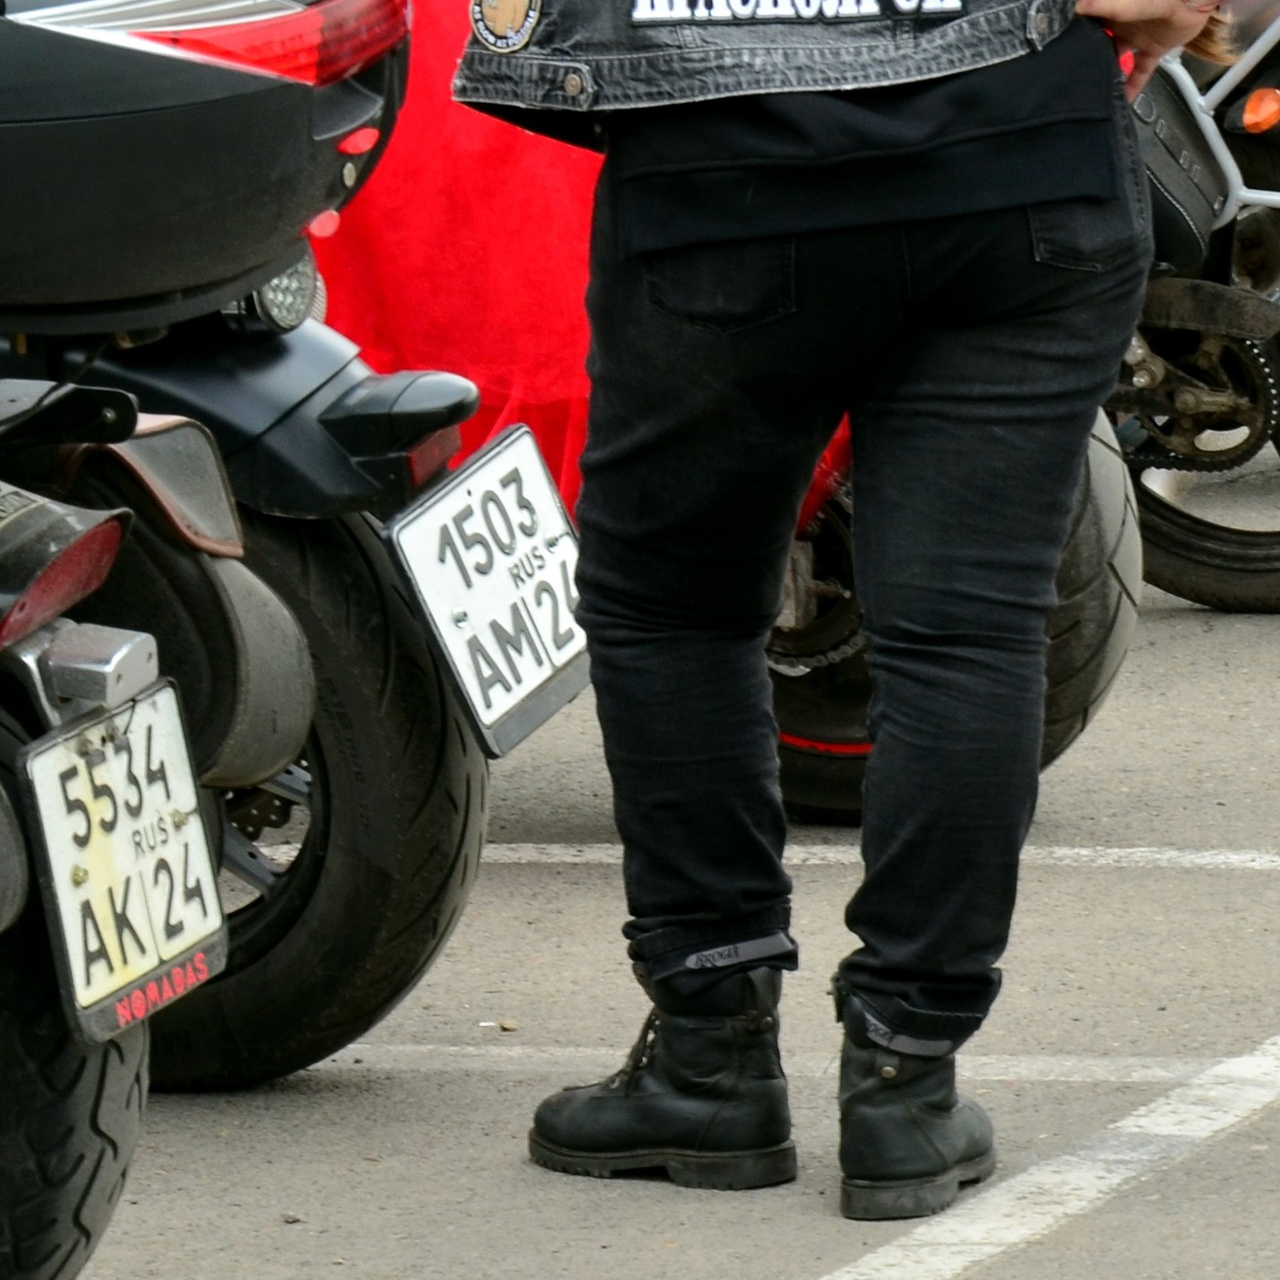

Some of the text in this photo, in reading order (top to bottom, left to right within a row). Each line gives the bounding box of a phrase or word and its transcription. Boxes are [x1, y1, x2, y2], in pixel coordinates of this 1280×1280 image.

[438, 467, 538, 588] 1503
[508, 546, 547, 588] RUS
[59, 724, 170, 849] 5534
[131, 818, 169, 860] RUS
[153, 841, 208, 941] 24
[115, 951, 210, 1027] NOMADAS
